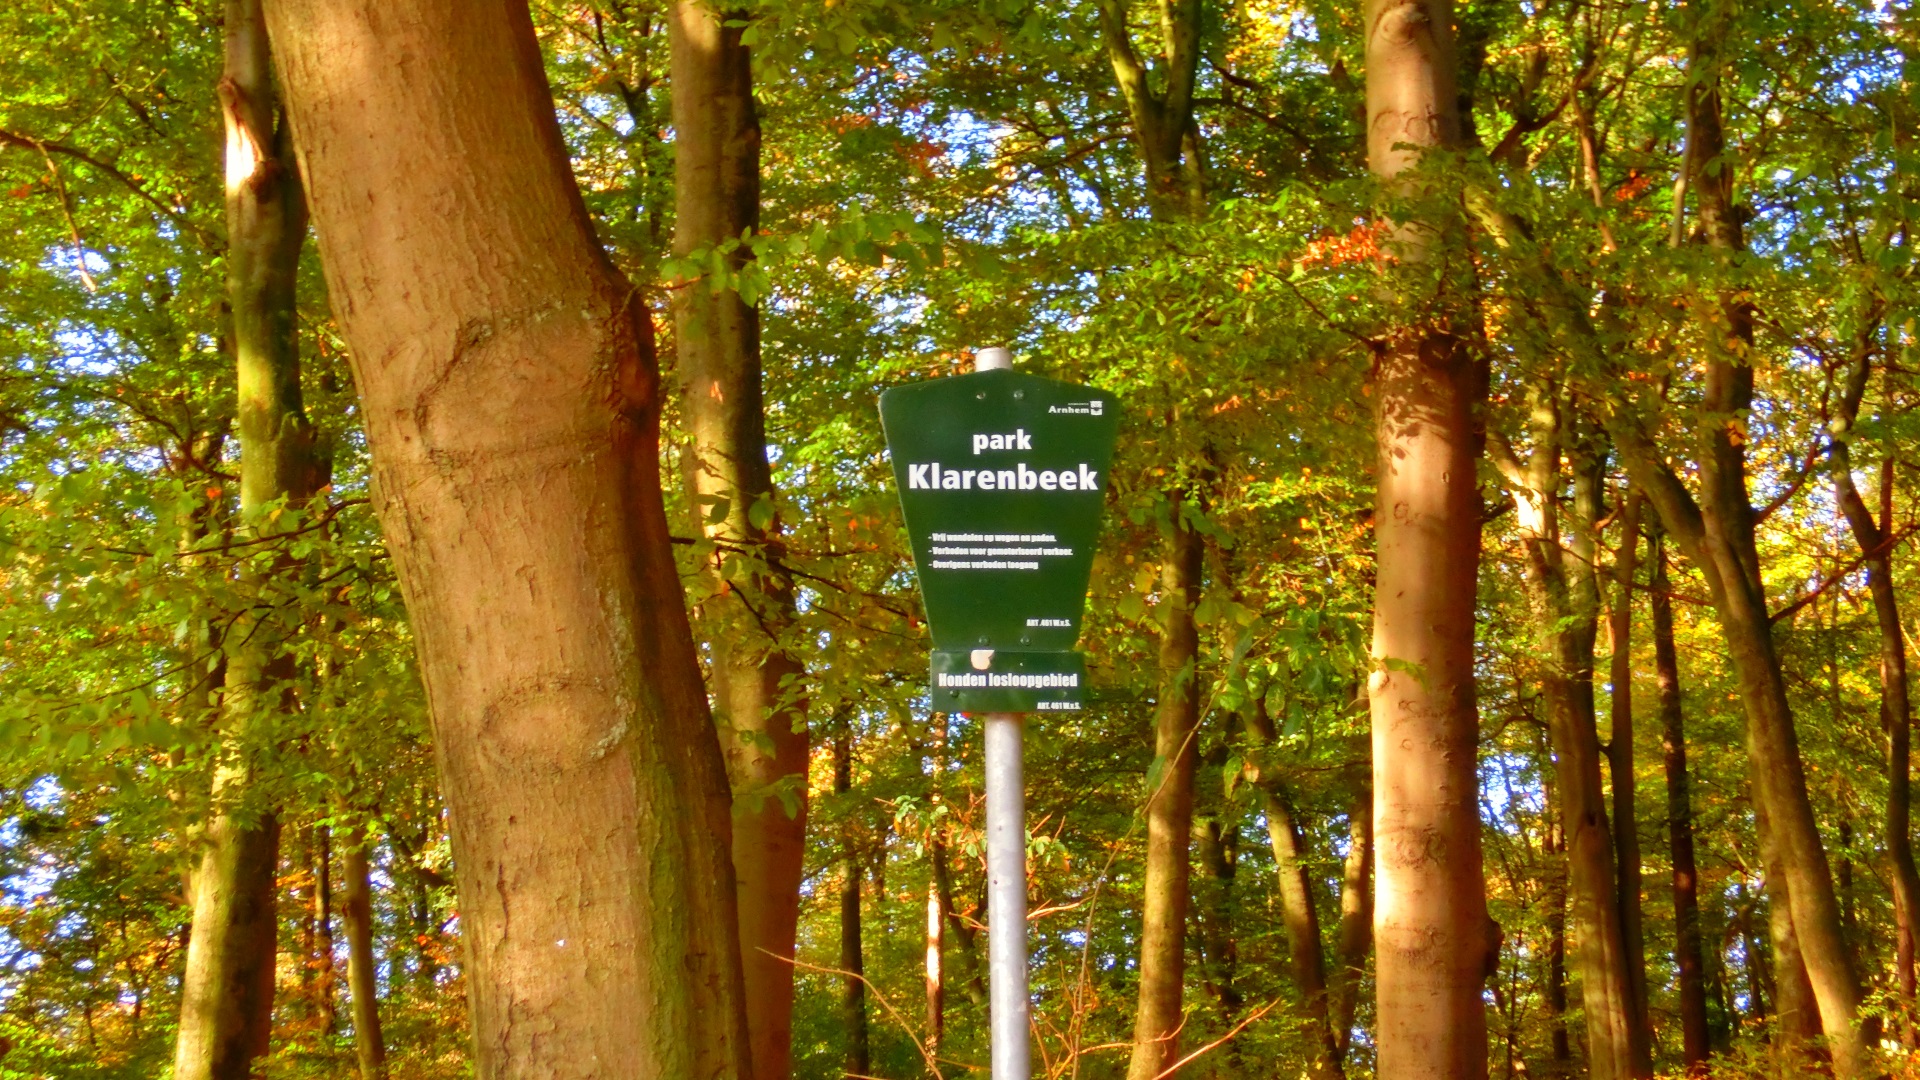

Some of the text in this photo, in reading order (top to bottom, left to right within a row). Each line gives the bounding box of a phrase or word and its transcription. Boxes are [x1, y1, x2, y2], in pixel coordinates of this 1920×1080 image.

[1048, 405, 1090, 414] Arnhem
[973, 429, 1032, 454] park
[908, 463, 1098, 490] Klarenbeek
[932, 533, 946, 542] Vrij
[947, 533, 983, 542] wandelen
[984, 534, 994, 542] op
[995, 534, 1020, 542] wegen
[1020, 534, 1031, 542] en
[1031, 534, 1057, 542] paden.
[932, 547, 969, 555] Verboden
[987, 547, 1042, 556] gemotoriseerd
[1043, 547, 1073, 555] verkeer.
[933, 560, 971, 569] Overigens
[971, 560, 1007, 569] verboden
[1007, 561, 1038, 569] toegang
[938, 673, 1077, 688] Honden losloopgebied
